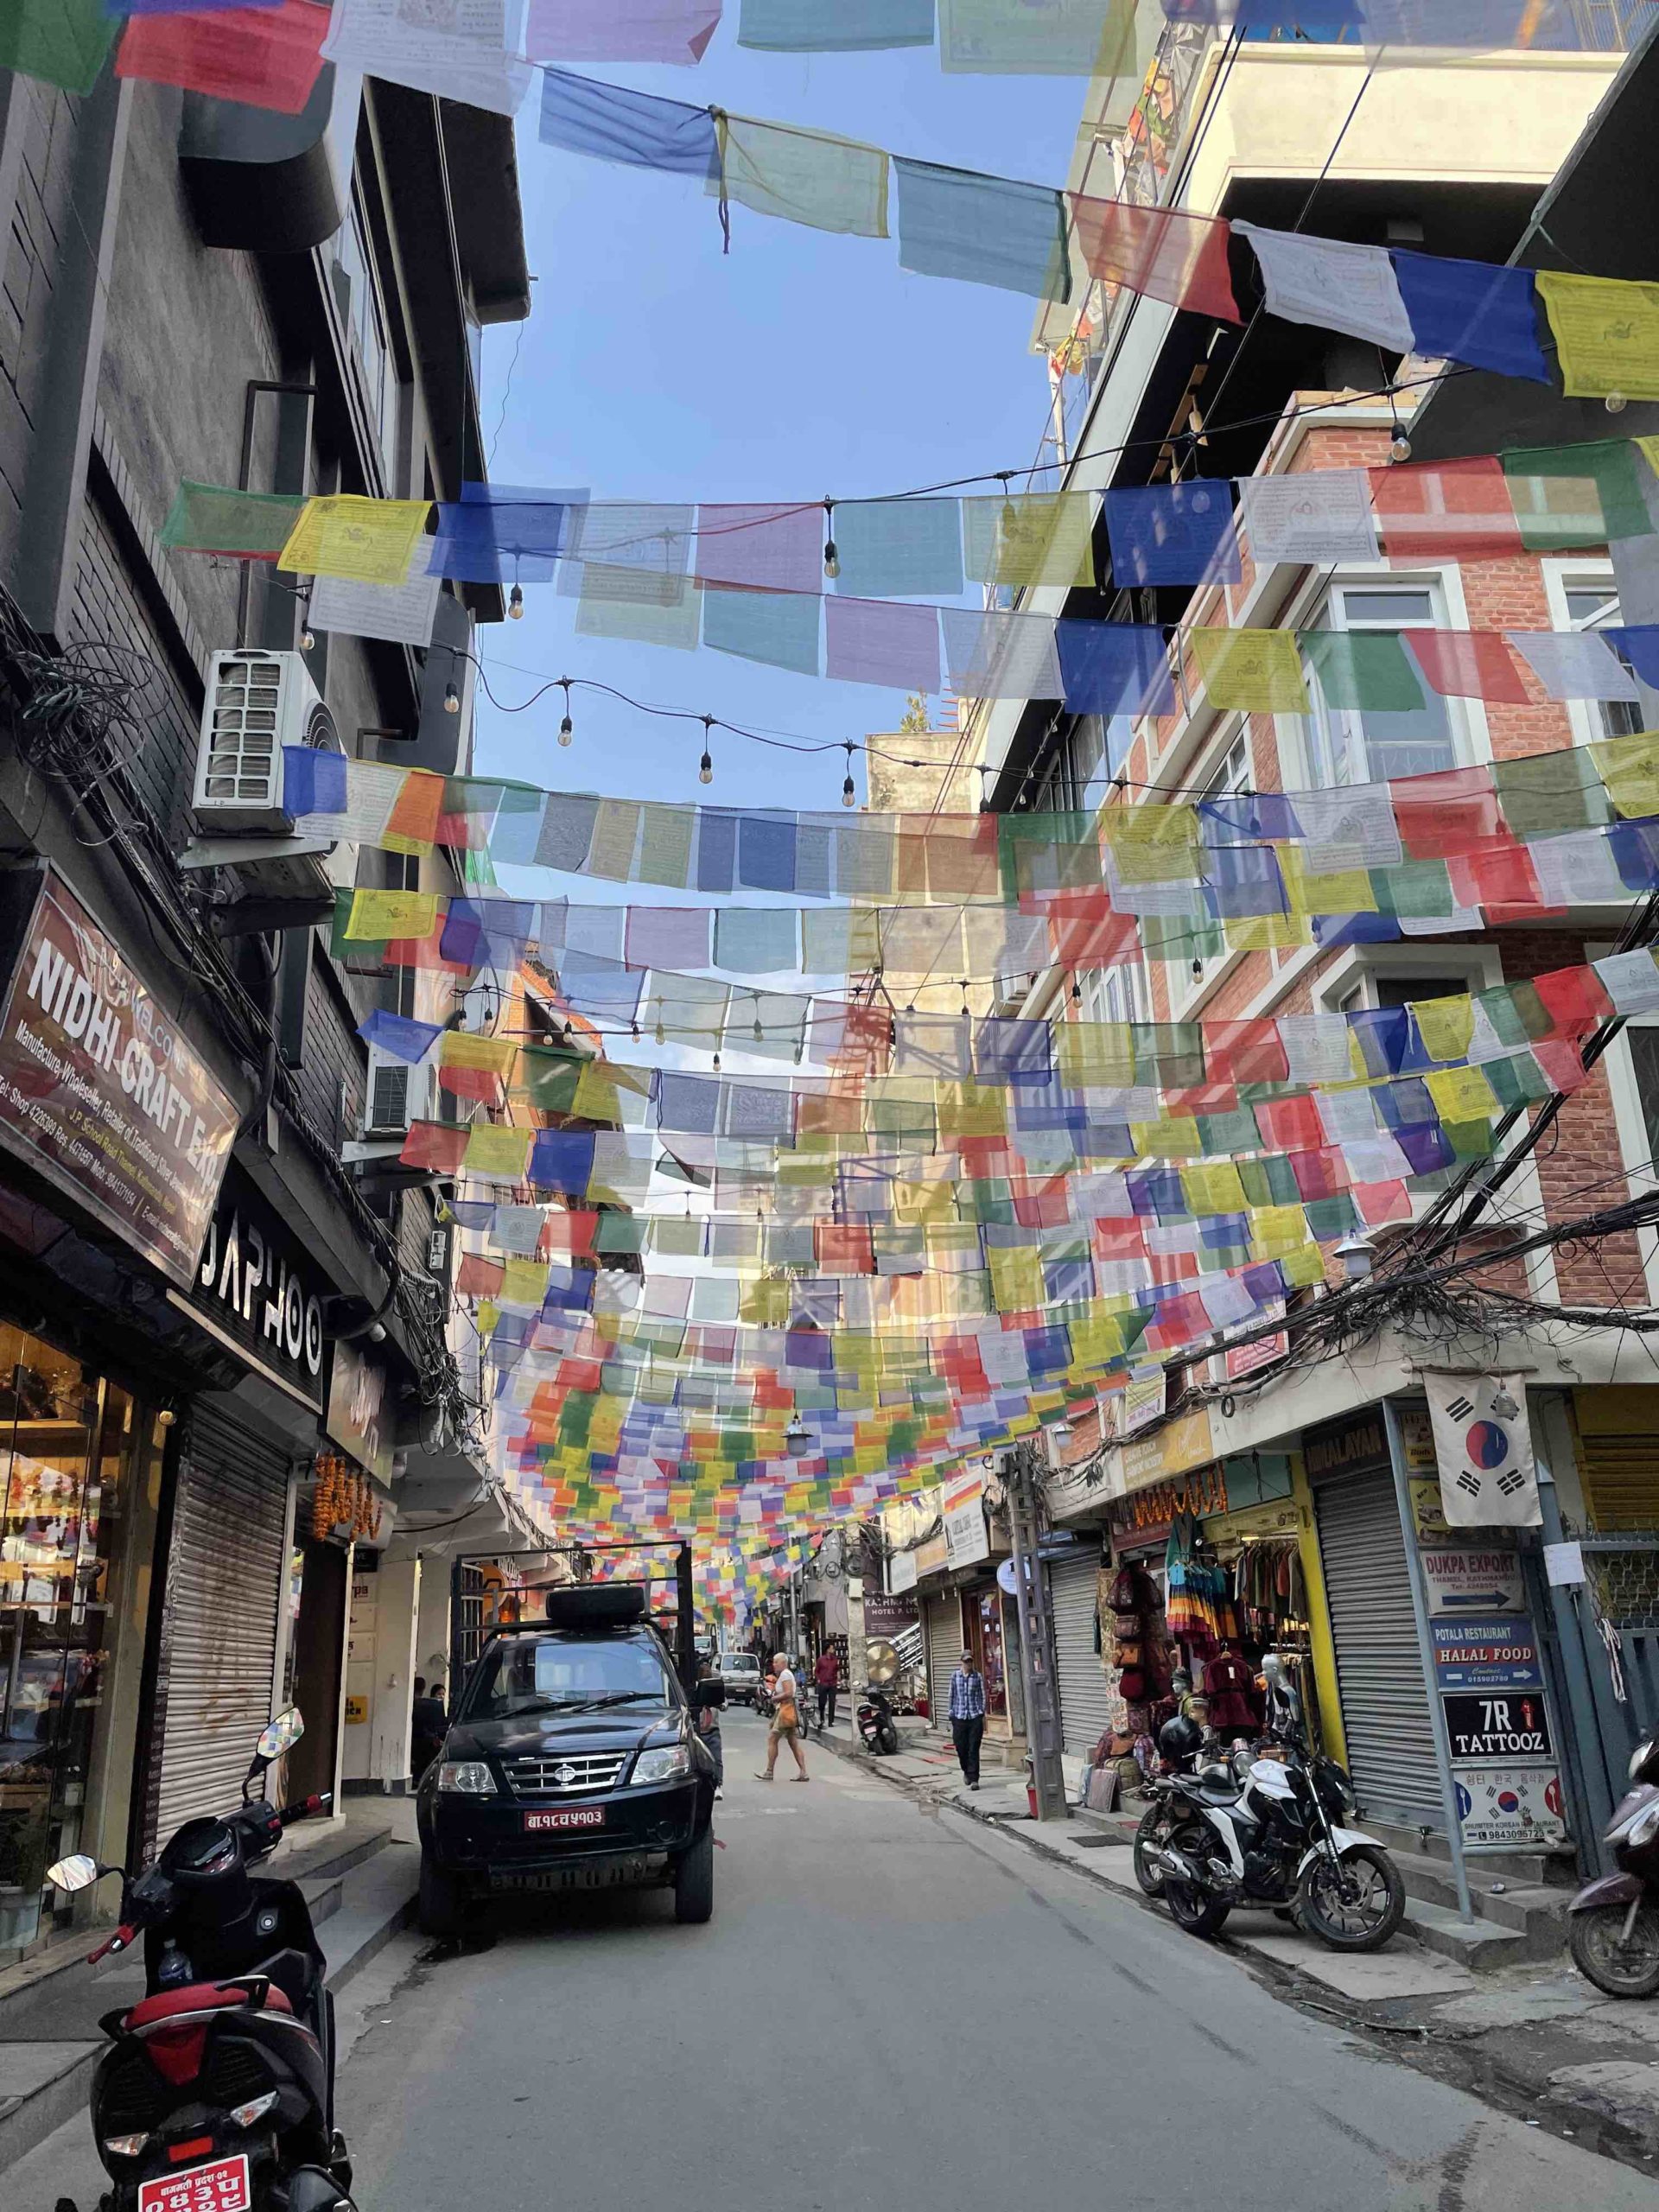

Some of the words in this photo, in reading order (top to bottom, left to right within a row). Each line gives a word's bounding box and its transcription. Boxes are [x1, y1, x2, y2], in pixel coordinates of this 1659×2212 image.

[27, 937, 122, 1073] NIDHI
[116, 1034, 192, 1151] CRAFT
[128, 995, 188, 1074] WELCOME
[14, 1018, 63, 1080] Manufacture,
[100, 1098, 126, 1136] Retailer
[123, 1121, 135, 1145] of
[0, 1074, 11, 1099] Tel:
[9, 1086, 29, 1117] Shop
[28, 1099, 57, 1138] 4226399
[54, 1123, 70, 1149] Res.
[90, 1155, 108, 1183] Mob:
[81, 1115, 104, 1147] School
[101, 1134, 118, 1160] Road
[1426, 1555, 1466, 1574] DUKPA
[1470, 1554, 1515, 1573] EXPORT
[1435, 1628, 1464, 1641] POTALA
[1465, 1626, 1511, 1640] RESTAURANT
[1440, 1648, 1488, 1662] HALAL
[1493, 1647, 1532, 1661] FOOD
[1479, 1700, 1512, 1732] 7R
[1456, 1732, 1545, 1753] TATTOOZ
[1494, 1773, 1512, 1785] 한국
